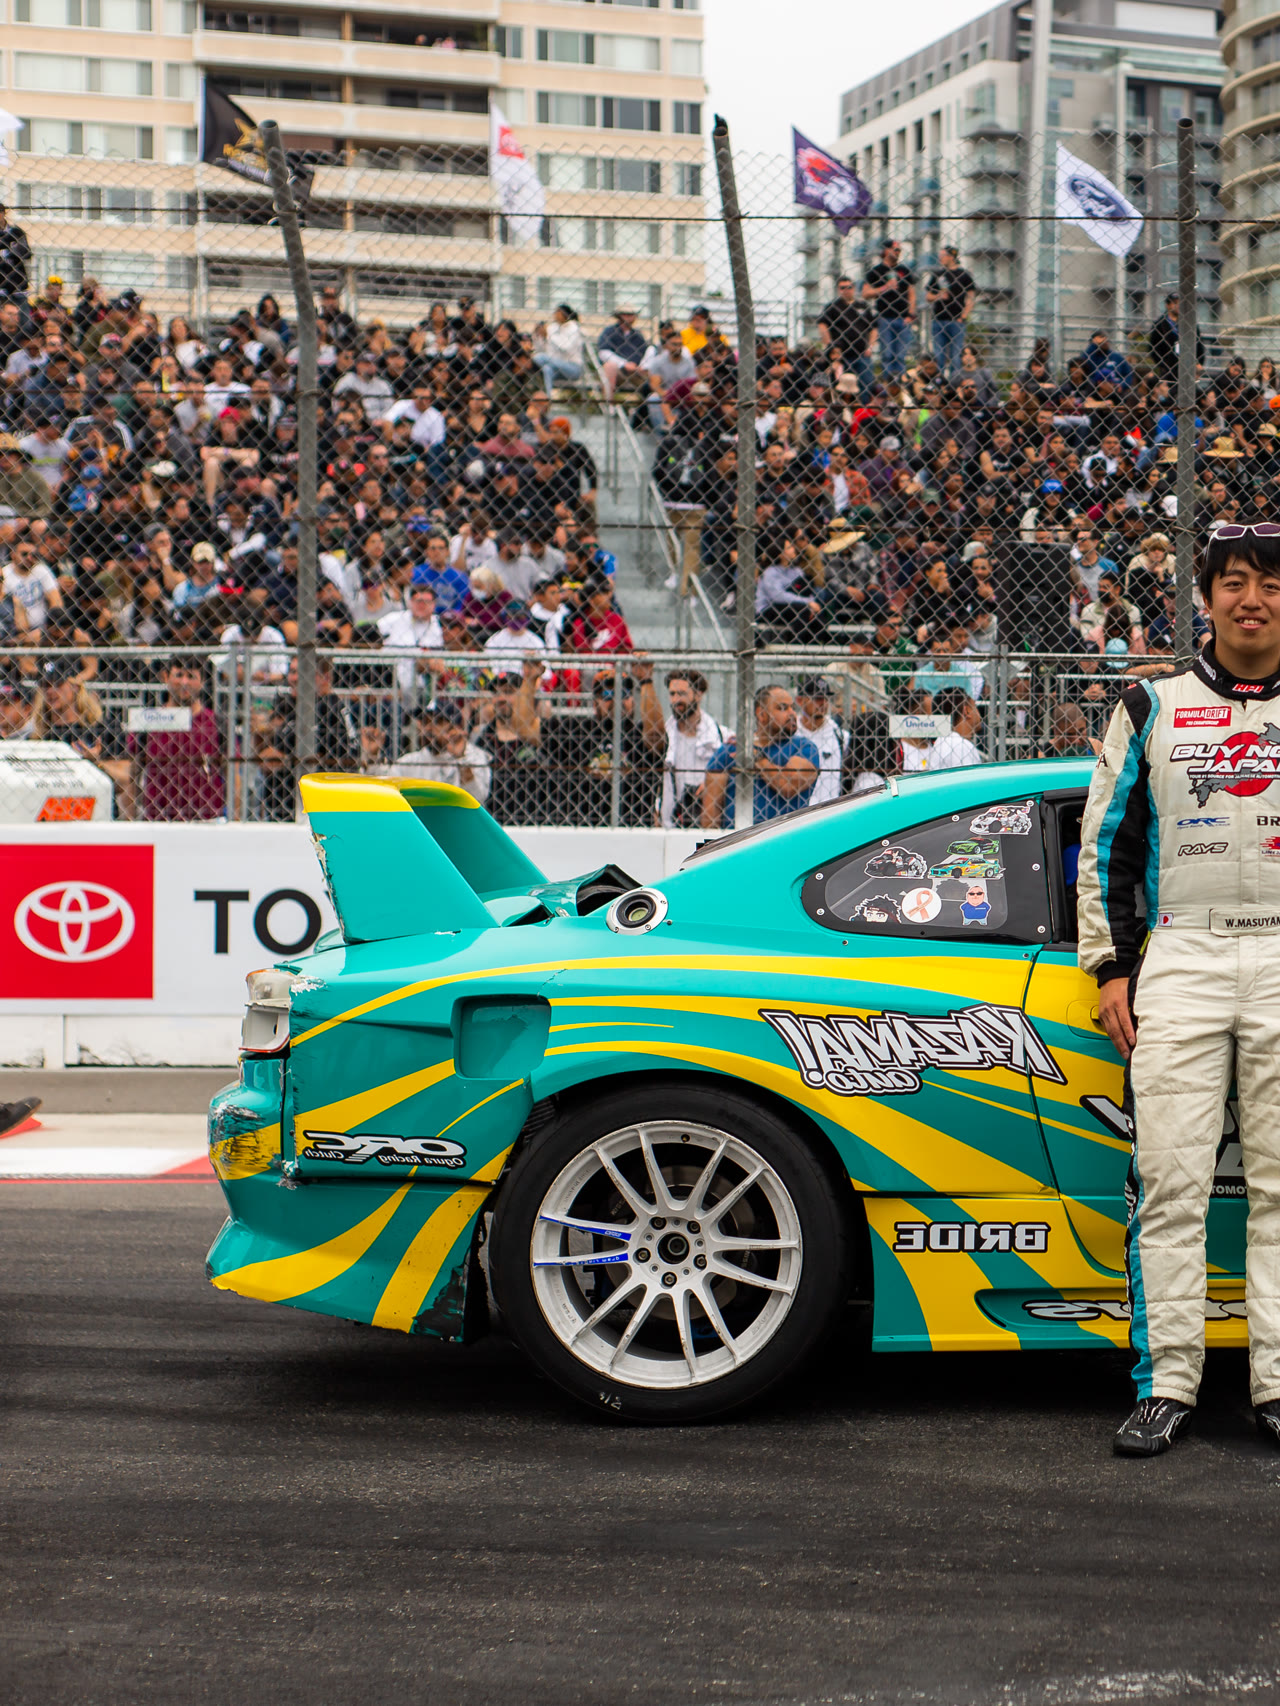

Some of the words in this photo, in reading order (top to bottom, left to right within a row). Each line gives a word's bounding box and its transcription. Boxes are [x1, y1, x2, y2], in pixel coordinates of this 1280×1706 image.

[1175, 709, 1205, 719] FORMULA
[1205, 708, 1228, 719] DRIFT
[905, 720, 935, 728] United
[1170, 744, 1245, 760] BUY
[1178, 842, 1229, 856] RAYS
[194, 889, 322, 955] TO
